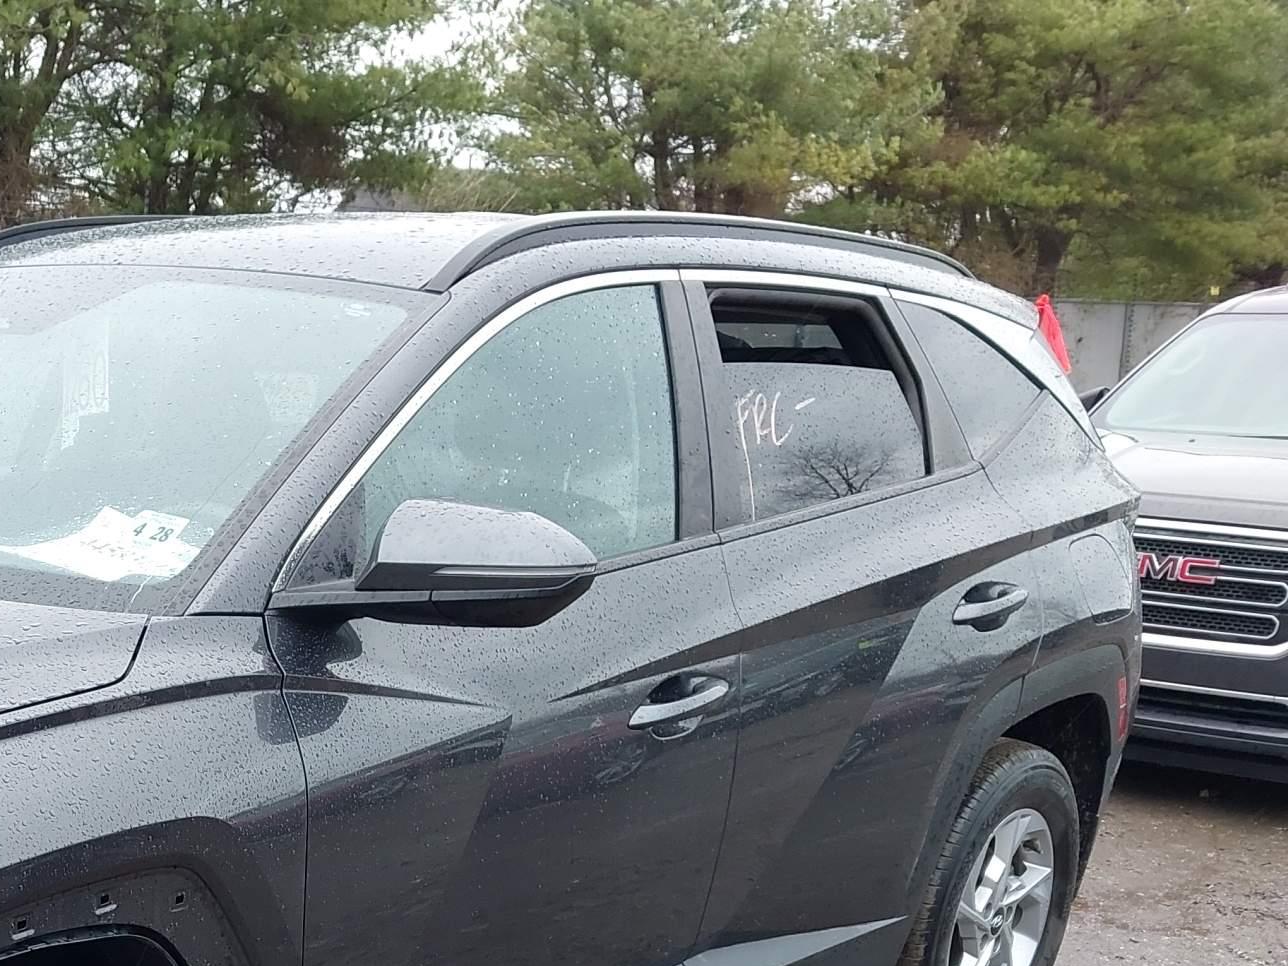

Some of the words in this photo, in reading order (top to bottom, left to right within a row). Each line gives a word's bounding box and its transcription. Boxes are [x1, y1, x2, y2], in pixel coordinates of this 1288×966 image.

[132, 522, 148, 537] 4
[149, 526, 174, 543] 28
[1136, 551, 1220, 585] MC
